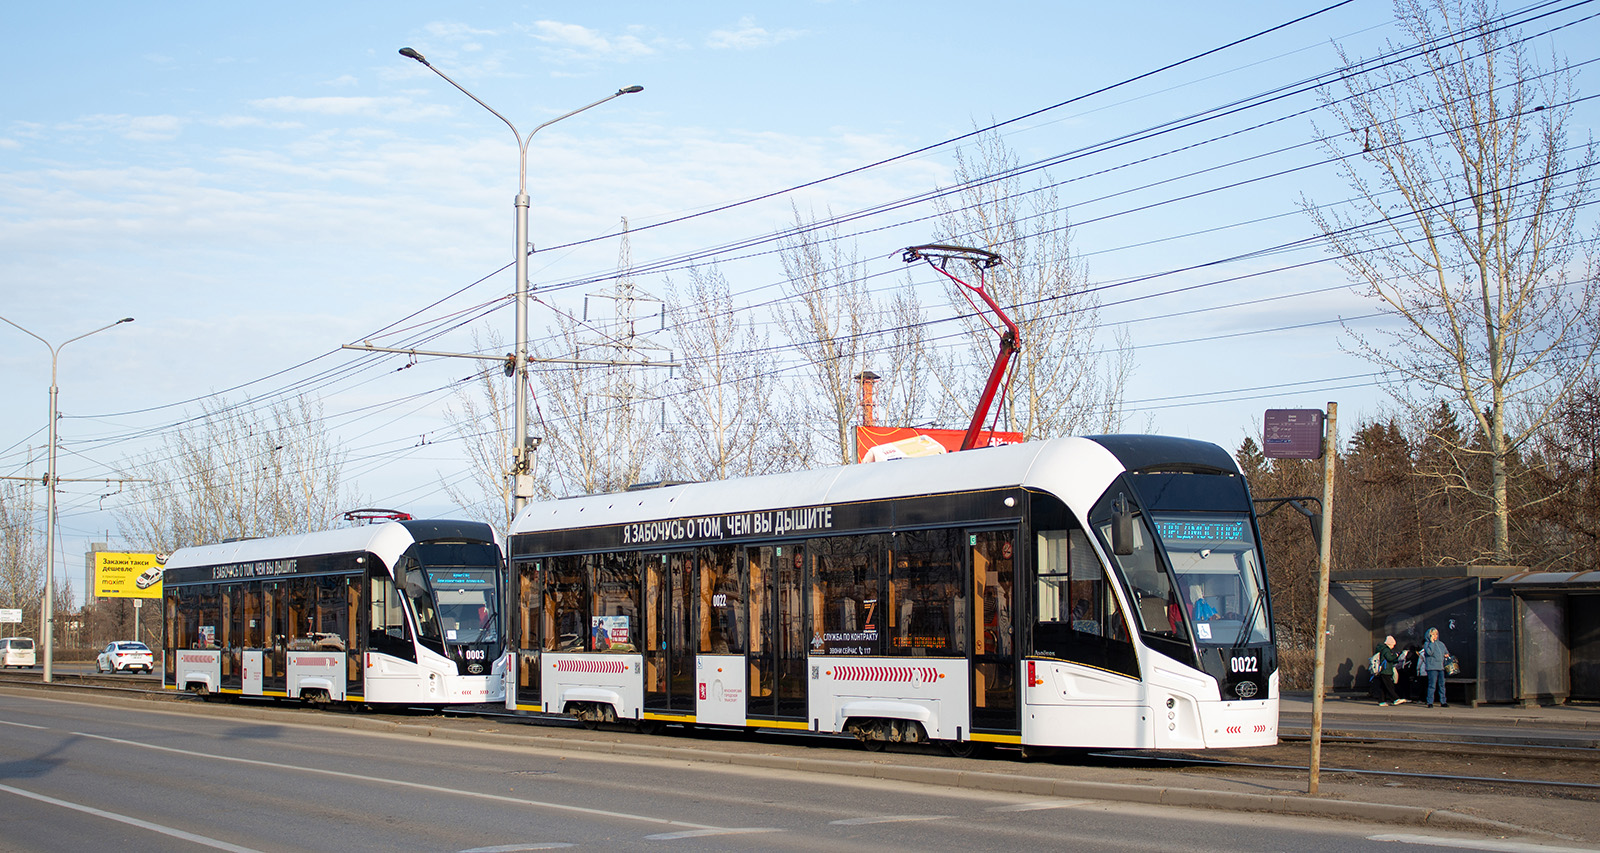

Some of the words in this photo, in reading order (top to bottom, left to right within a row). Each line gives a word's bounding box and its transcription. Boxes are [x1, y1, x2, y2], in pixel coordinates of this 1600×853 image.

[623, 525, 631, 543] Я
[631, 520, 685, 543] ЗАБОЧУСЬ
[687, 519, 695, 539] О
[697, 516, 723, 540] ТОМ,
[726, 514, 750, 535] ЧЕМ
[754, 512, 772, 533] ВЫ
[775, 506, 832, 535] ДЫШИТЕ
[713, 594, 727, 607] 0022
[823, 633, 843, 641] СЛУЖБА
[843, 633, 851, 641] ПО
[851, 632, 878, 641] КОНТРАКТУ
[466, 650, 485, 660] 0003
[1231, 656, 1258, 673] 0022
